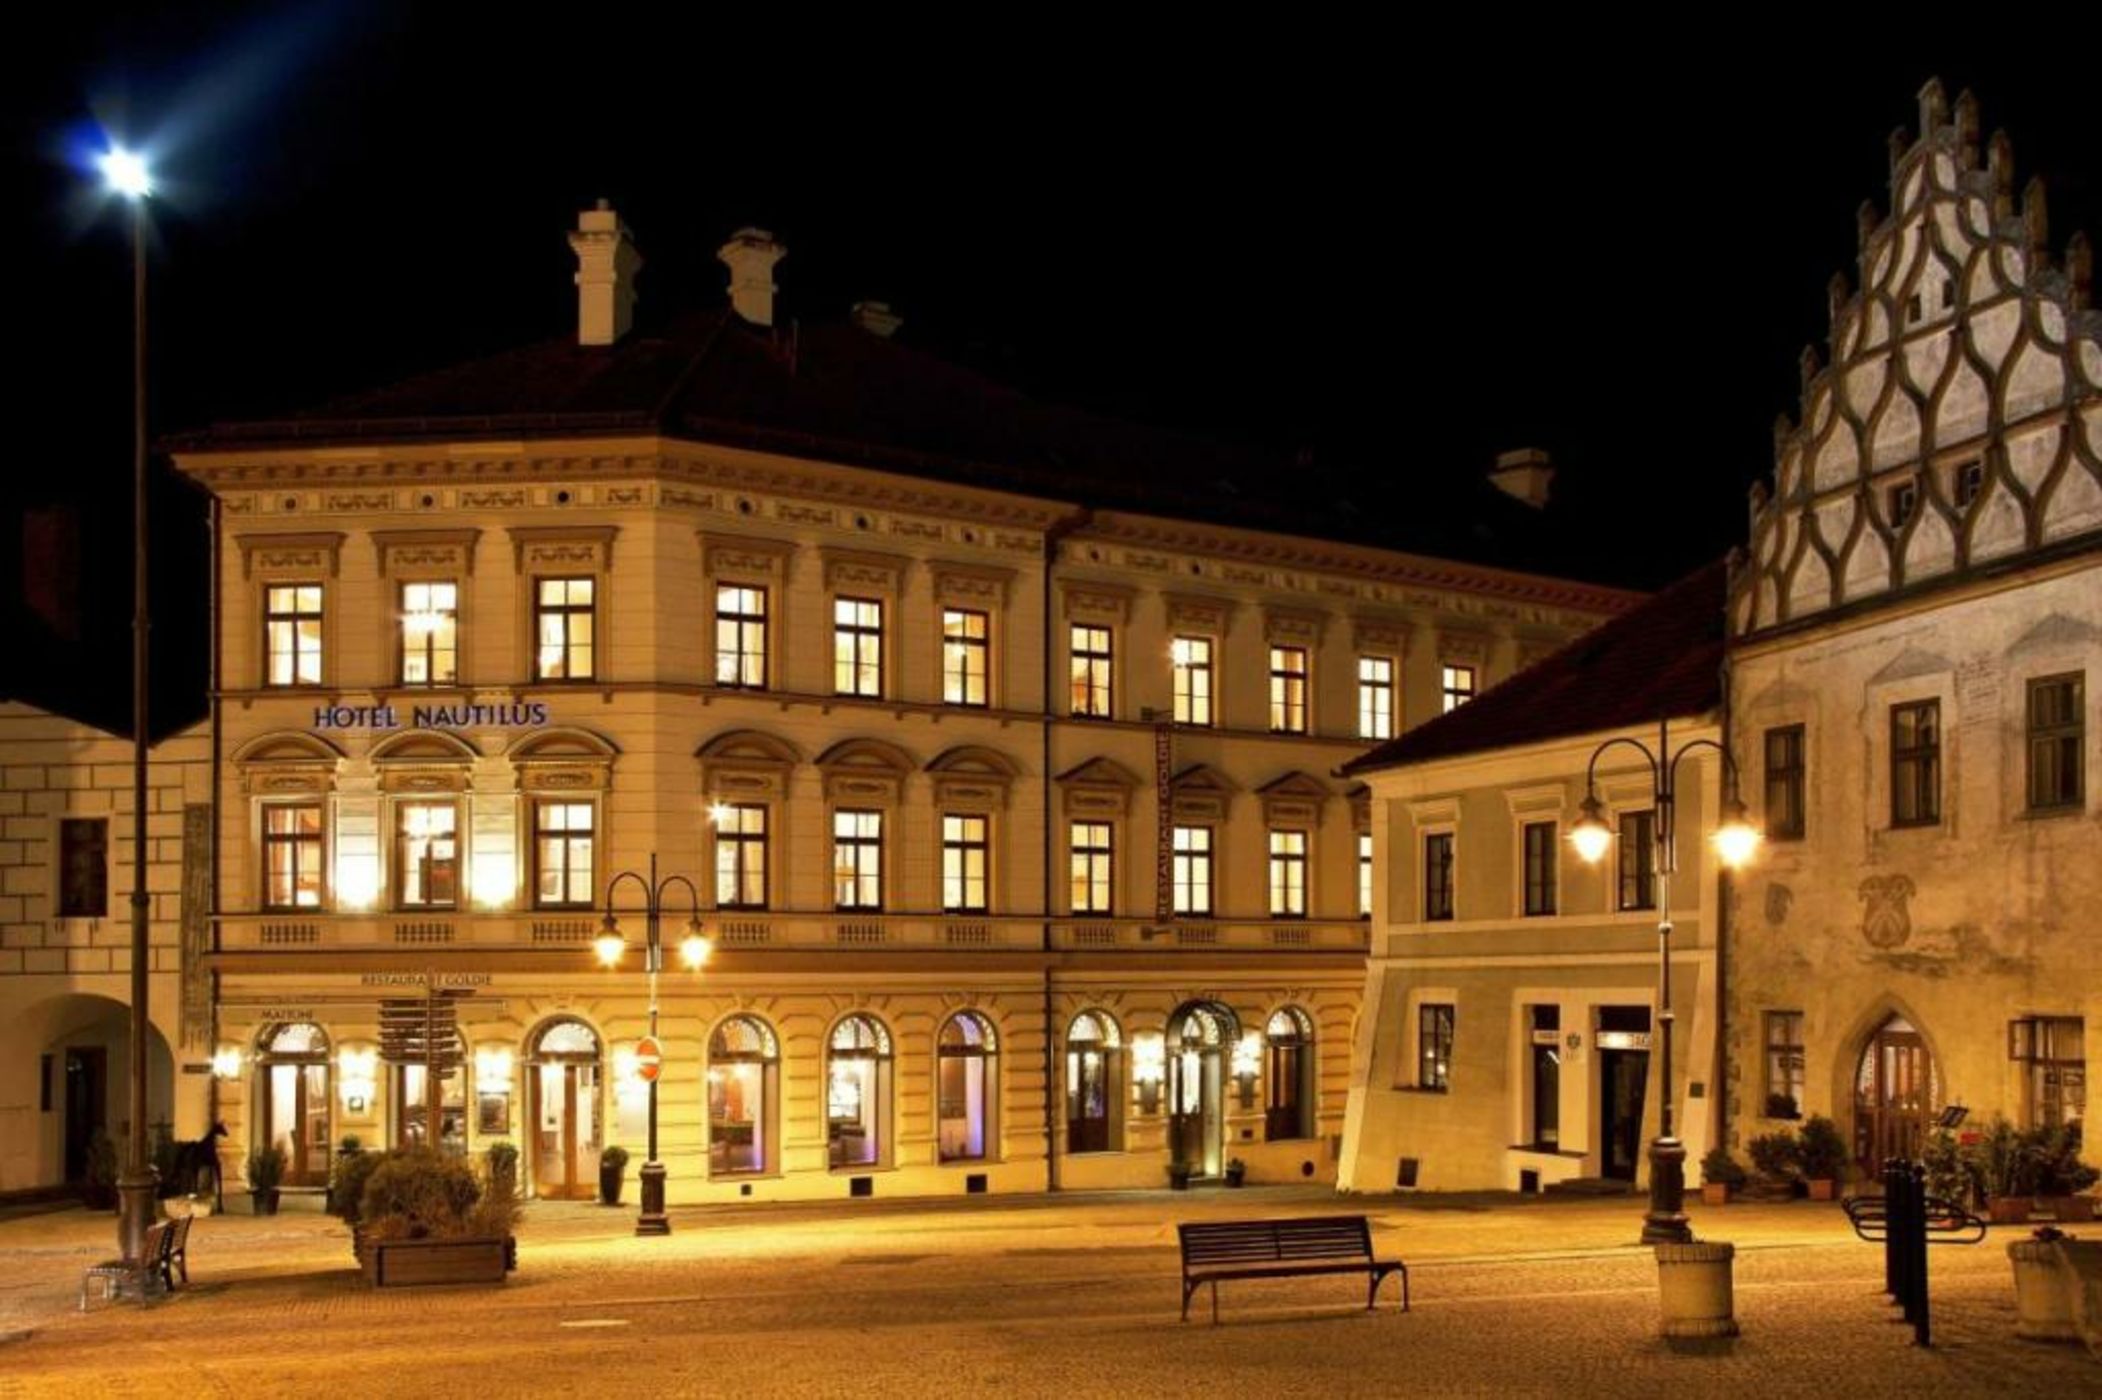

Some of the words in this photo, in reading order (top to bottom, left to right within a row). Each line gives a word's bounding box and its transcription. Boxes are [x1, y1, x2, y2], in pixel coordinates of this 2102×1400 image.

[314, 705, 397, 728] HOTEL
[413, 703, 546, 727] NAUTILUS
[362, 974, 441, 986] RESTAURAT
[445, 974, 493, 986] GOLDIE
